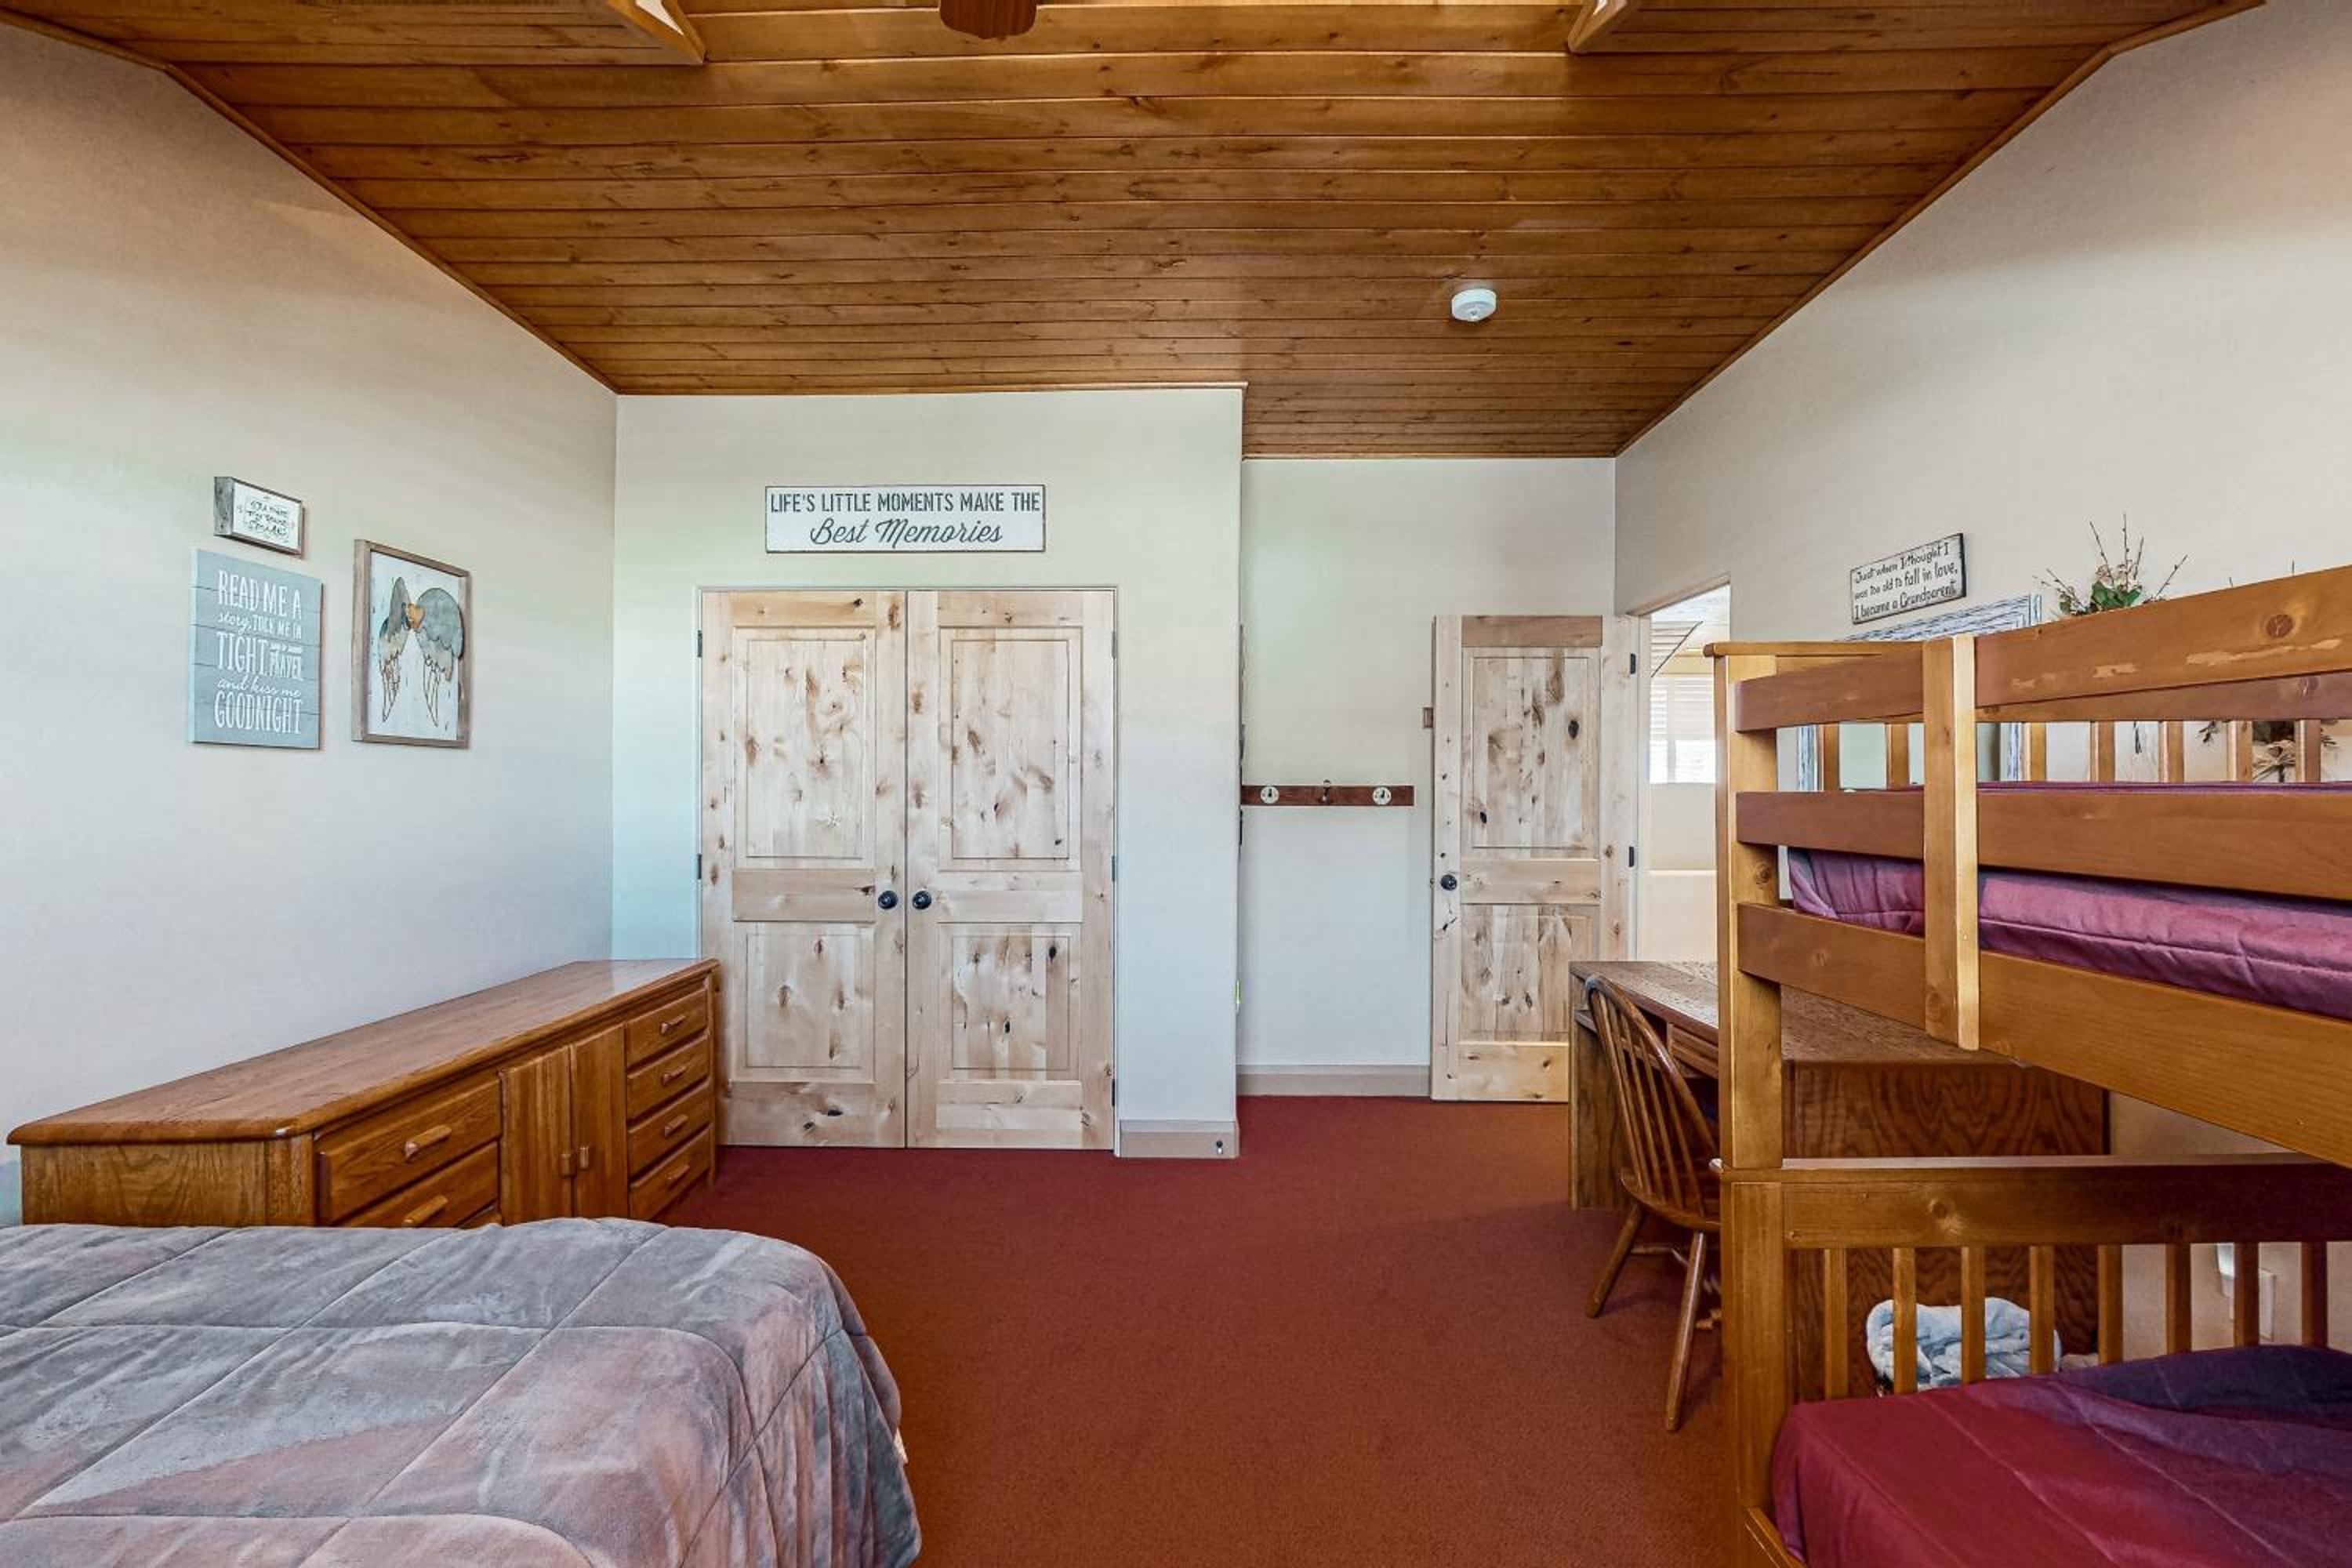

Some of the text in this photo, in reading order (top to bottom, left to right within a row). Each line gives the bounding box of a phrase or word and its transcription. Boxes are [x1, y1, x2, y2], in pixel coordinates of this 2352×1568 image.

[771, 492, 1040, 513] LIFE'S LITTLE MOMENTS MAKE THE
[810, 517, 1003, 549] Best Memories
[1855, 542, 1949, 583] Just when I thought I
[1882, 578, 1893, 592] old
[1904, 568, 1919, 586] fall
[1922, 568, 1932, 581] in
[1934, 561, 1958, 579] love,
[218, 570, 302, 620] READ ME A
[1855, 604, 1859, 619] I
[1860, 601, 1889, 617] became
[277, 620, 289, 637] ME
[215, 690, 303, 734] GOODNIGHT
